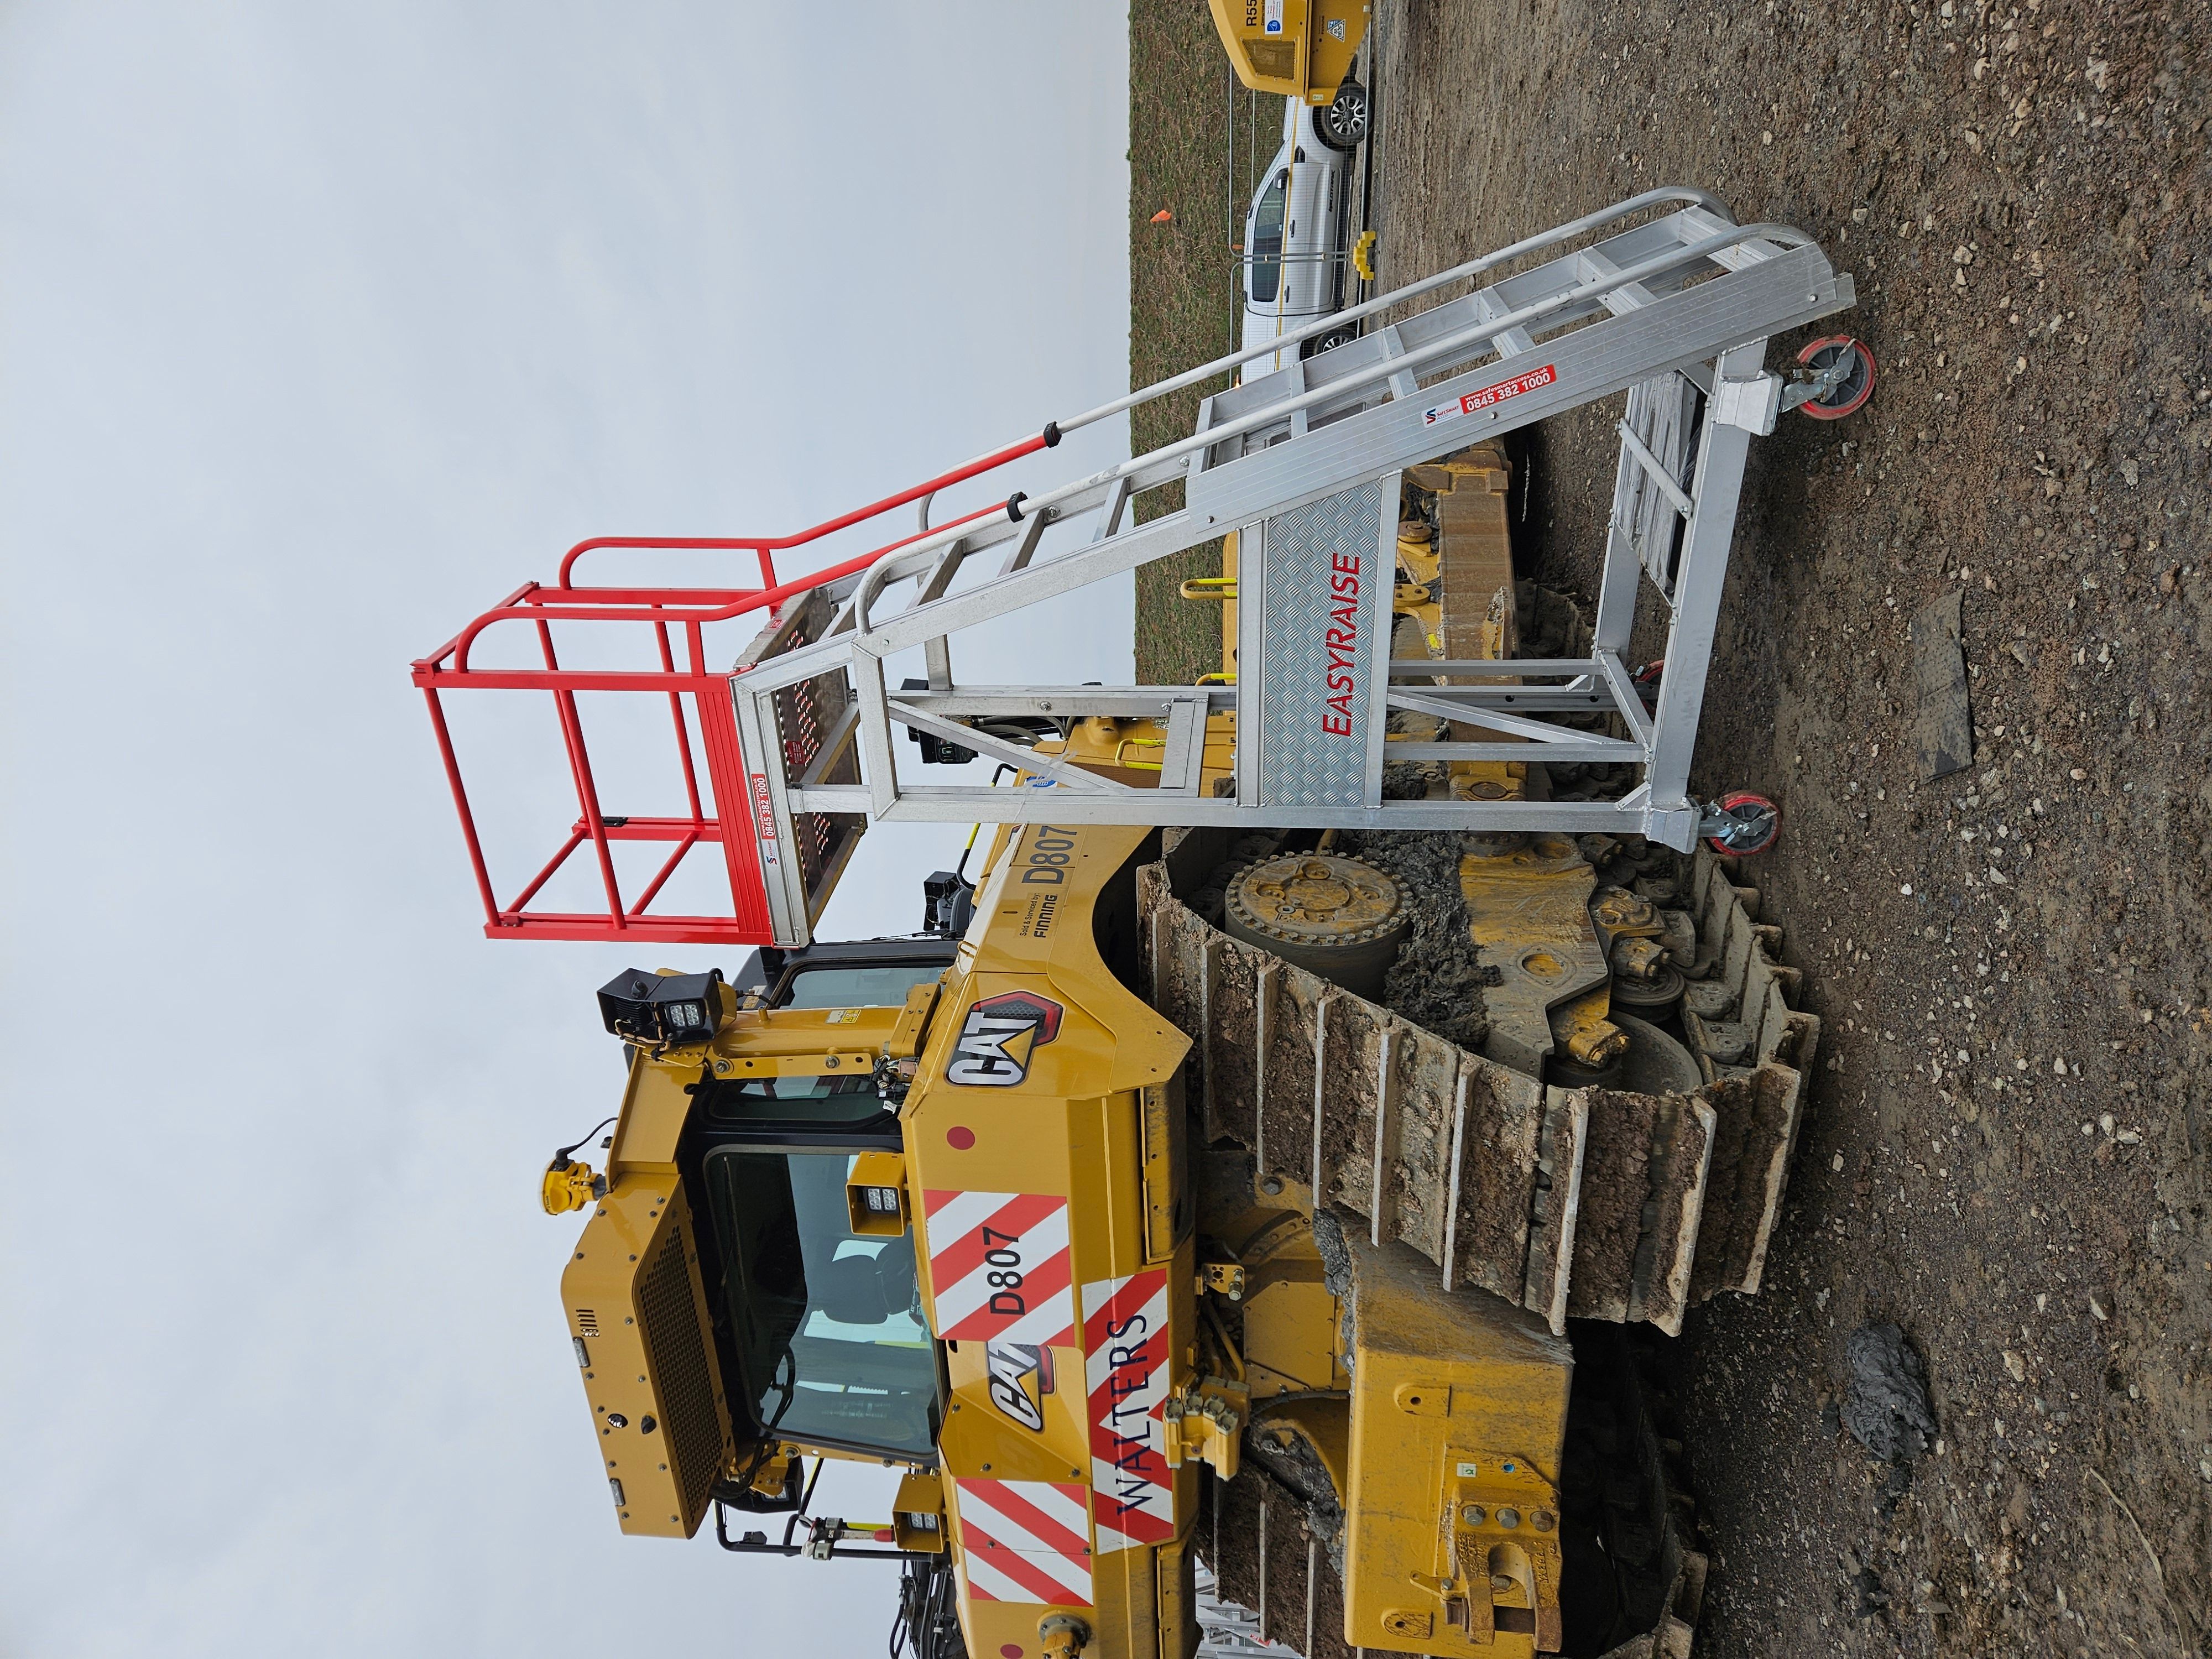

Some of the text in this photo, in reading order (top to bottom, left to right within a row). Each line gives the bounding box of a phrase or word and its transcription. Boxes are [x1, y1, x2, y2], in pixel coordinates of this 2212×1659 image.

[1465, 367, 1548, 401] www.safesmartaccess.co.uk
[1467, 372, 1550, 411] 0845 382 1000
[1322, 553, 1360, 736] EASYRAISE
[753, 778, 766, 836] www.safesmartaccess.co.uk
[757, 778, 774, 836] 0845 382 1000
[1021, 826, 1077, 884] D807
[1019, 925, 1029, 936] Sold
[1025, 901, 1037, 920] Serviced
[1034, 894, 1058, 938] FINNING
[948, 1011, 1037, 1084] CAT
[983, 1227, 1025, 1315] D807
[1107, 1314, 1153, 1516] WALTERS
